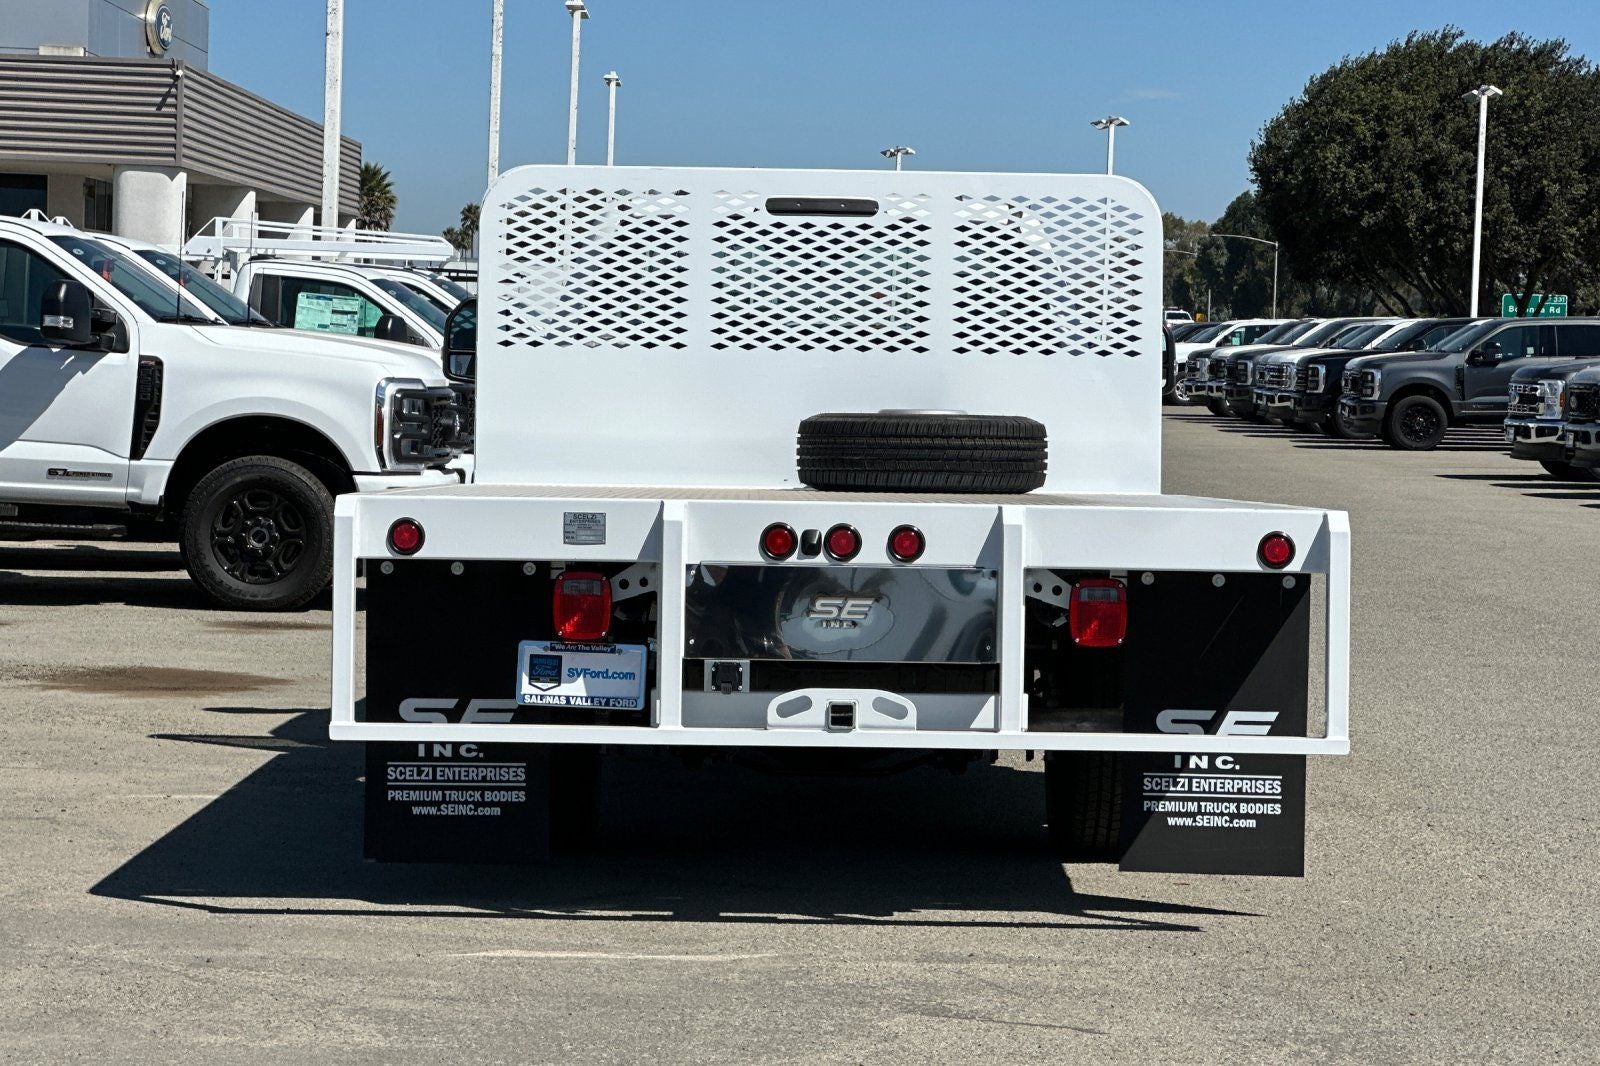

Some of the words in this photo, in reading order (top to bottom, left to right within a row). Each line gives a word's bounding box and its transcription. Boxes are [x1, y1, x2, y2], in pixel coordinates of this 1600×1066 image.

[1550, 306, 1561, 314] Rd
[809, 596, 876, 619] SE
[567, 667, 636, 680] SVFord.com
[524, 694, 567, 705] SALINAS
[569, 696, 606, 706] VALLEY
[609, 697, 637, 707] FORD
[387, 766, 433, 780] SCELZI
[436, 767, 526, 782] ENTERPRISES
[1143, 777, 1189, 791] SCELZI
[1192, 778, 1282, 794] ENTERPRISES
[387, 790, 442, 801] PREMIUM
[444, 790, 482, 802] TRUCK
[484, 791, 526, 802] BODIES
[411, 804, 501, 816] www.SEINC.com
[1143, 801, 1198, 812] PREMIUM
[1200, 801, 1238, 814] TRUCK
[1239, 802, 1282, 815] BODIES
[1167, 816, 1257, 828] www.SEINC.com
